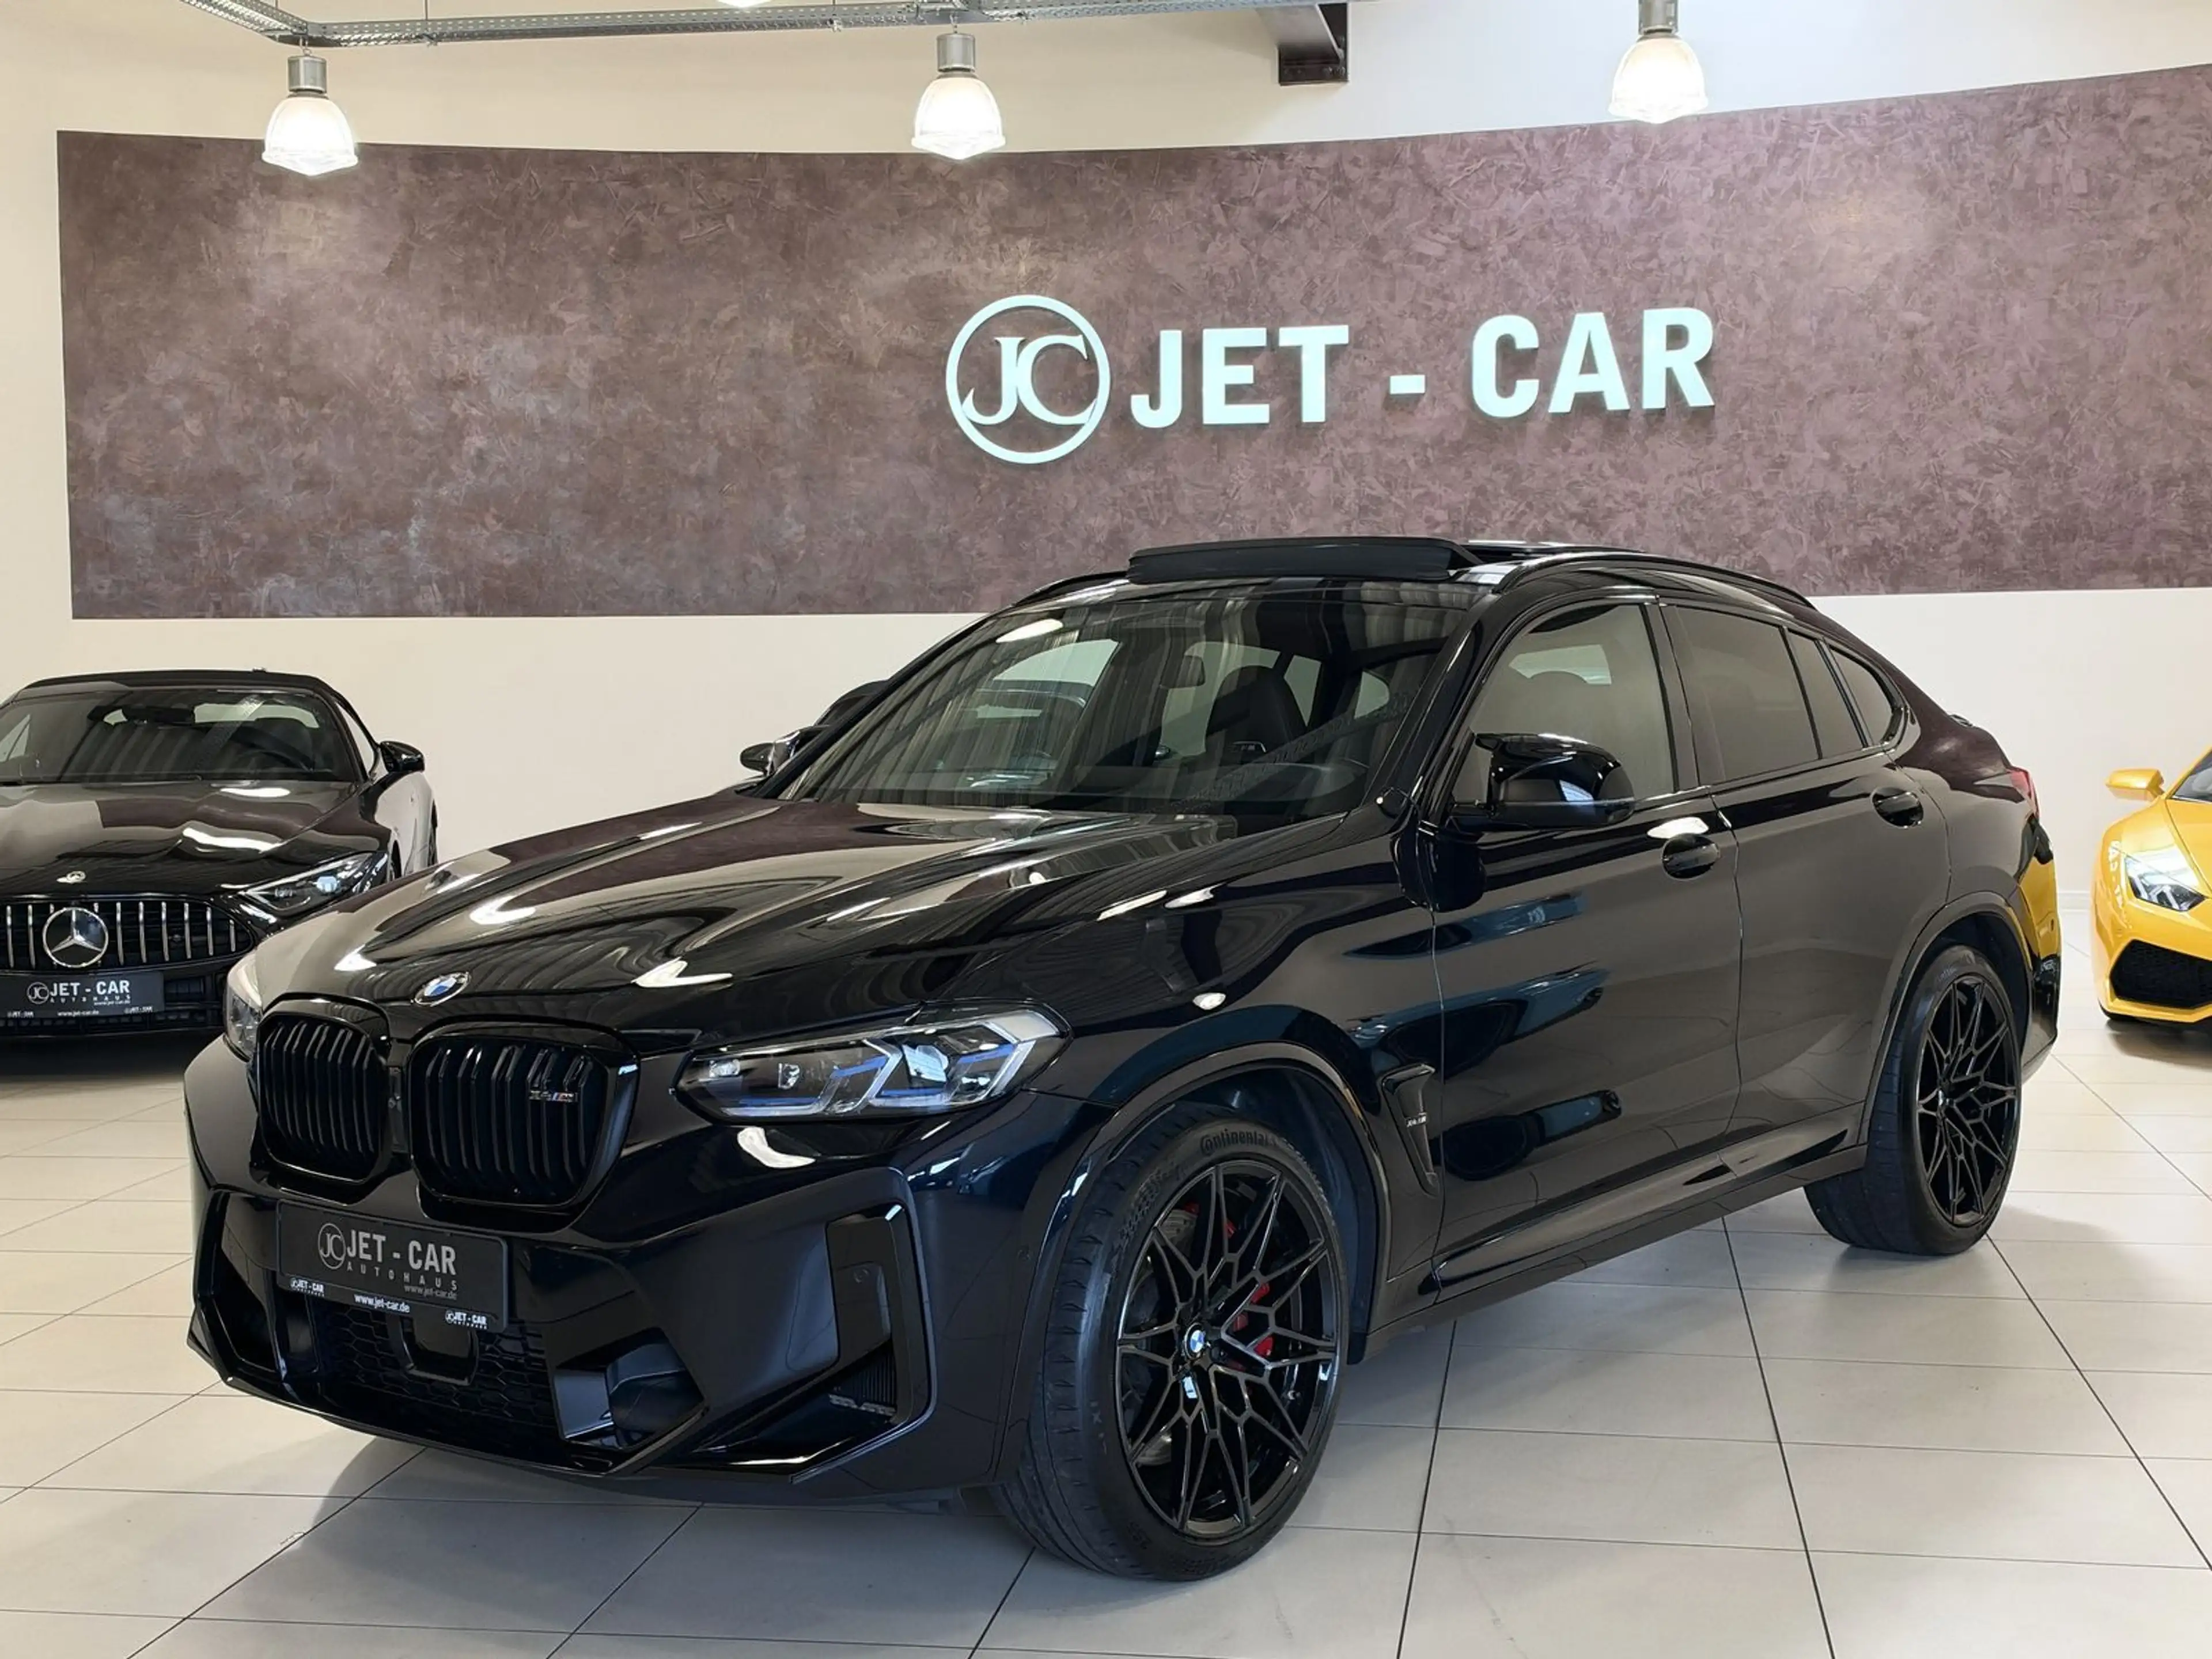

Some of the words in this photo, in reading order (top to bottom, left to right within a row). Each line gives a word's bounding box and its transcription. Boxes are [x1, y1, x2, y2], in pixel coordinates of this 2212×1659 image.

[1130, 324, 1350, 429] JET
[1389, 374, 1426, 396] -
[1471, 306, 1715, 418] CAR
[50, 983, 80, 997] JET
[96, 980, 130, 995] CAR
[347, 1229, 387, 1262] JET
[392, 1251, 400, 1260] -
[408, 1240, 456, 1275] CAR
[347, 1262, 458, 1291] AUTOHAUS
[353, 1293, 410, 1313] www.jet-car.de
